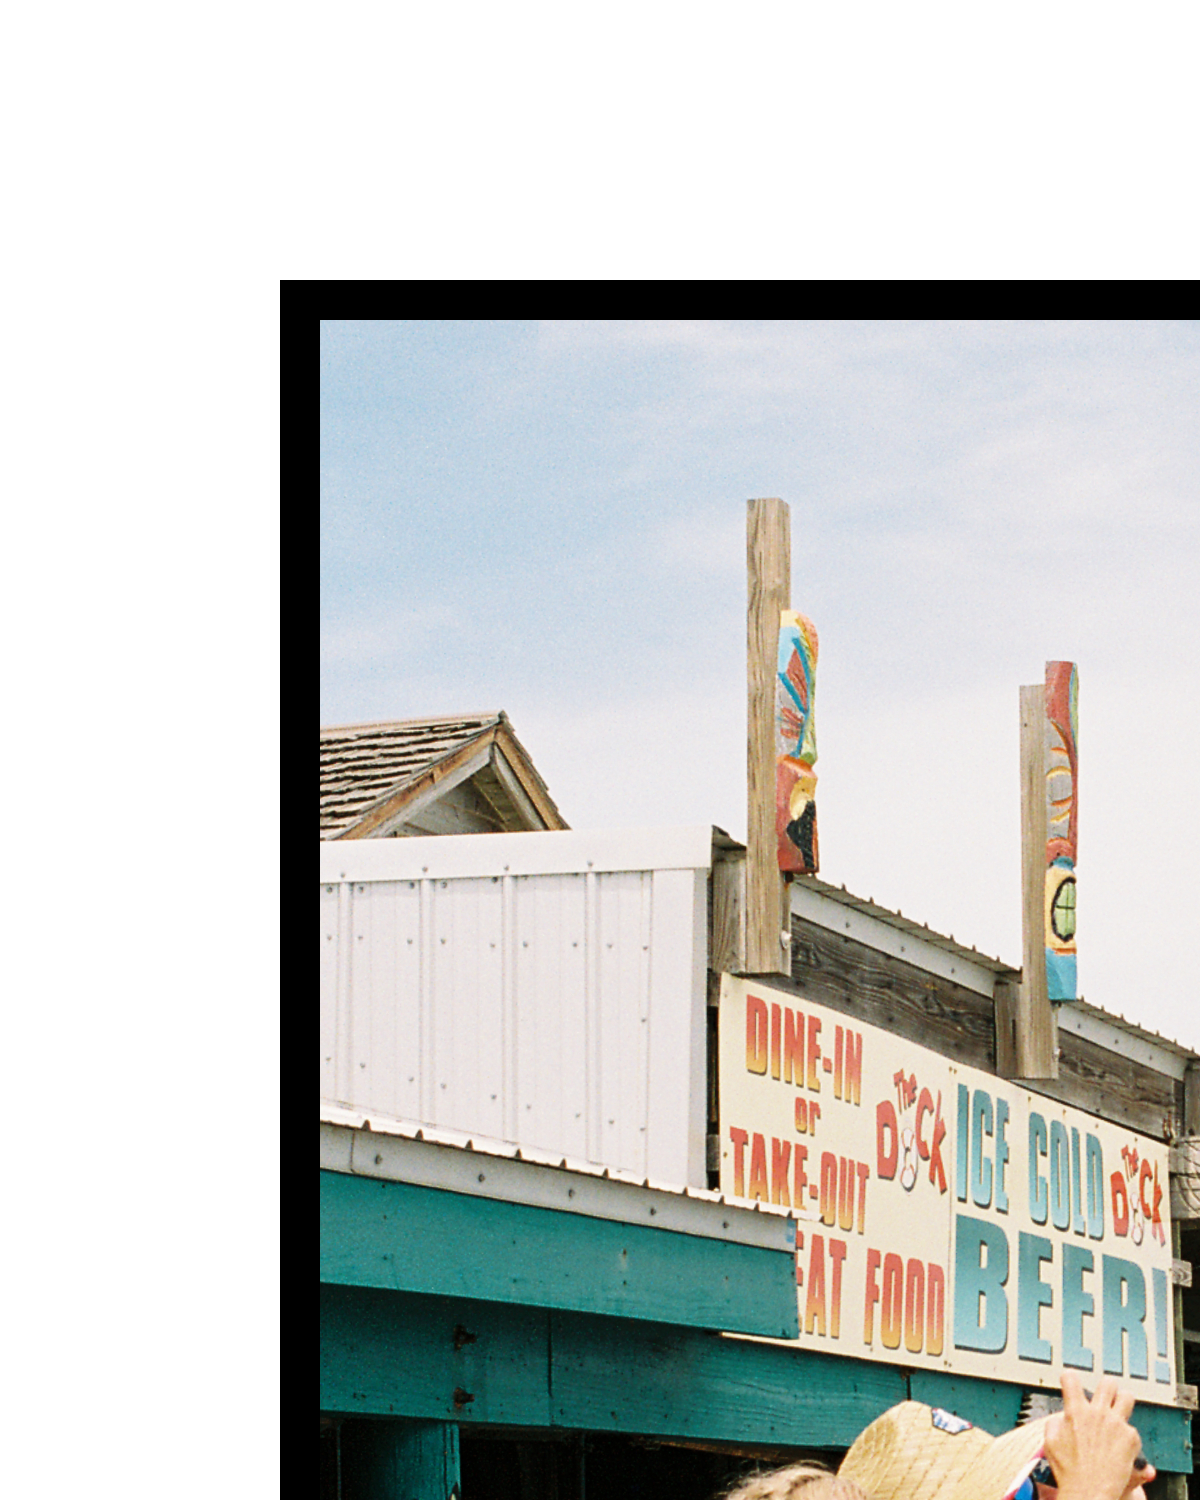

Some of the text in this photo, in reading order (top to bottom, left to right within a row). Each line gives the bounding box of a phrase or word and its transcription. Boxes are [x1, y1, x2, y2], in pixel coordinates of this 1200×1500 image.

[746, 994, 863, 1106] DINE-IN
[730, 1126, 870, 1235] TAKE-OUT
[957, 1083, 1104, 1241] ICE COLD
[864, 1248, 945, 1357] FOOD
[954, 1213, 1171, 1385] BEER!
